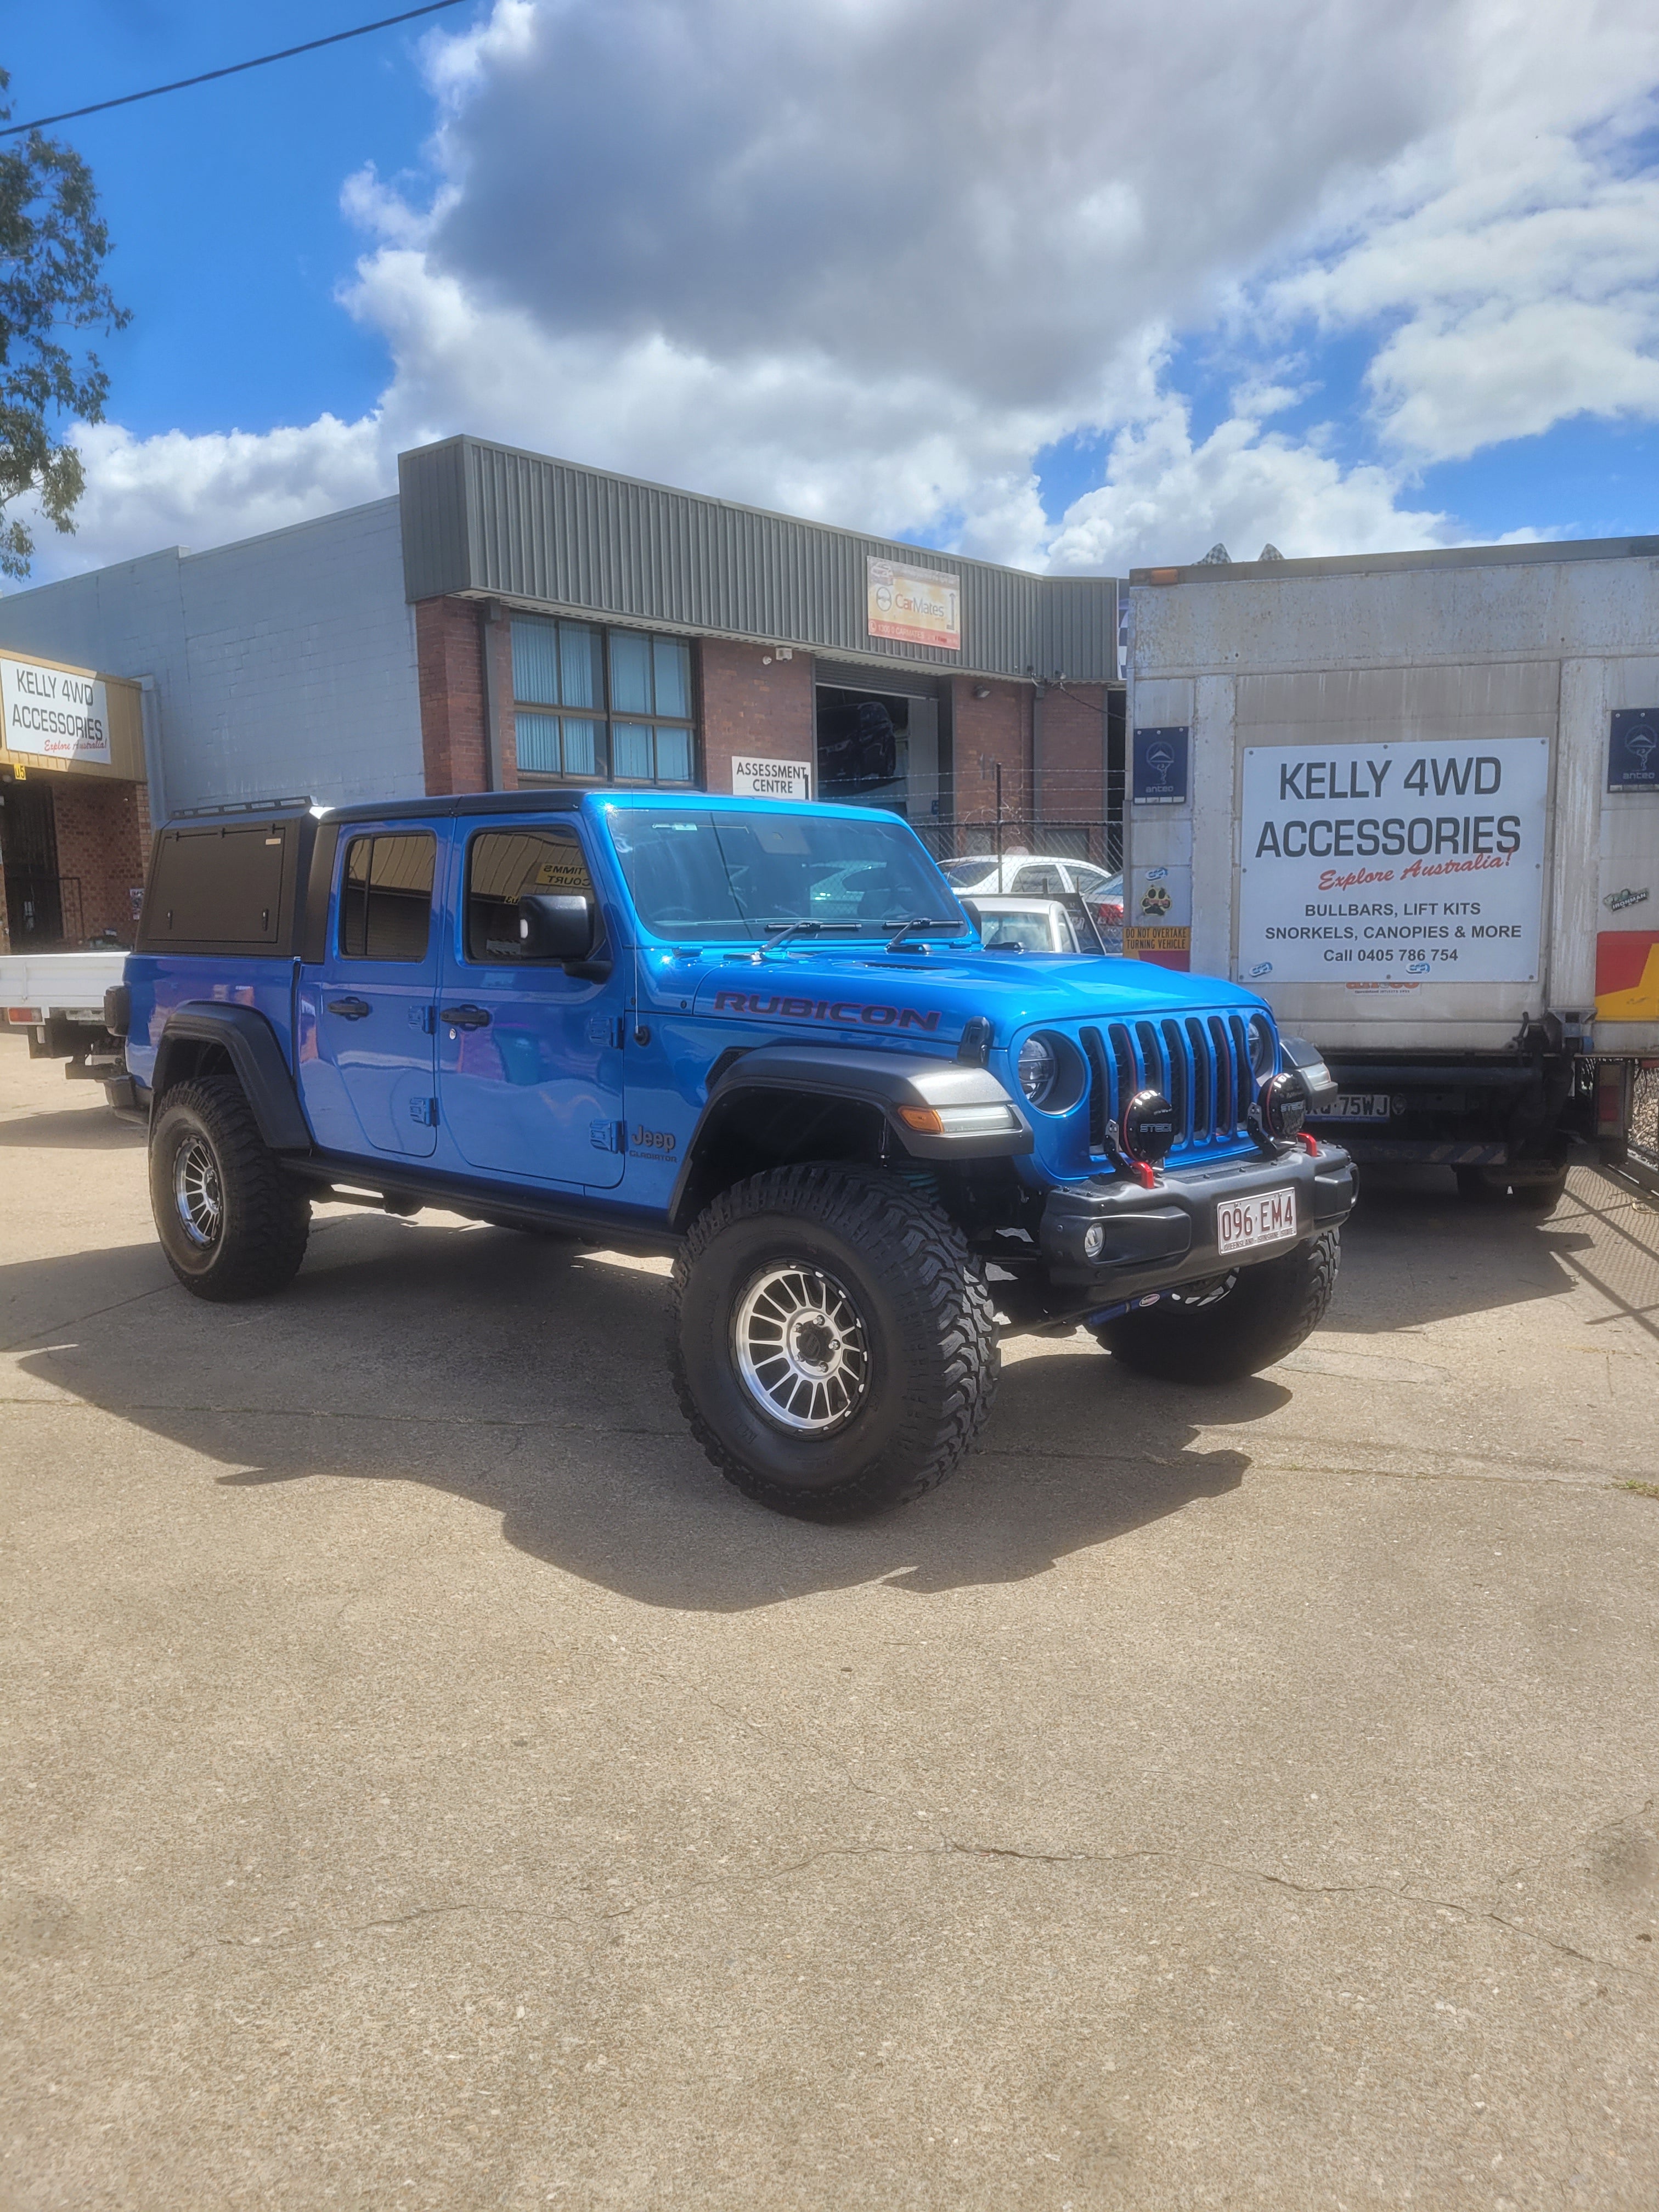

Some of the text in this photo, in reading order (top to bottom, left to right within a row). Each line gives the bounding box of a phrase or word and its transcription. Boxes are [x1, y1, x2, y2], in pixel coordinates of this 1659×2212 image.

[895, 593, 944, 617] CarMates
[16, 668, 93, 707] KELLY 4WD
[12, 703, 103, 741] ACCESSORIES
[44, 738, 107, 752] Explore Australia!
[736, 761, 806, 780] ASSESSMENT
[1280, 757, 1502, 800] KELLY 4WD
[753, 778, 793, 794] CENTRE
[1255, 815, 1521, 858] ACCESSORIES
[1318, 847, 1515, 891] Explore Australia!
[1305, 902, 1481, 918] BULLBARS, LIFT KITS
[1612, 892, 1646, 910] IRONMAN
[1126, 928, 1135, 938] DO
[1137, 928, 1150, 938] NOT
[1153, 928, 1187, 938] OVERTAKE
[1265, 925, 1522, 941] SNORKELS, CANOPIES & MORE
[1127, 939, 1186, 949] TURNING VEHICLE
[1323, 949, 1458, 962] Call 0405 786 754
[714, 991, 942, 1031] RUBICON
[631, 1124, 675, 1153] Jeep
[629, 1150, 678, 1163] GLADIATOR
[1222, 1195, 1293, 1241] 096 EM4
